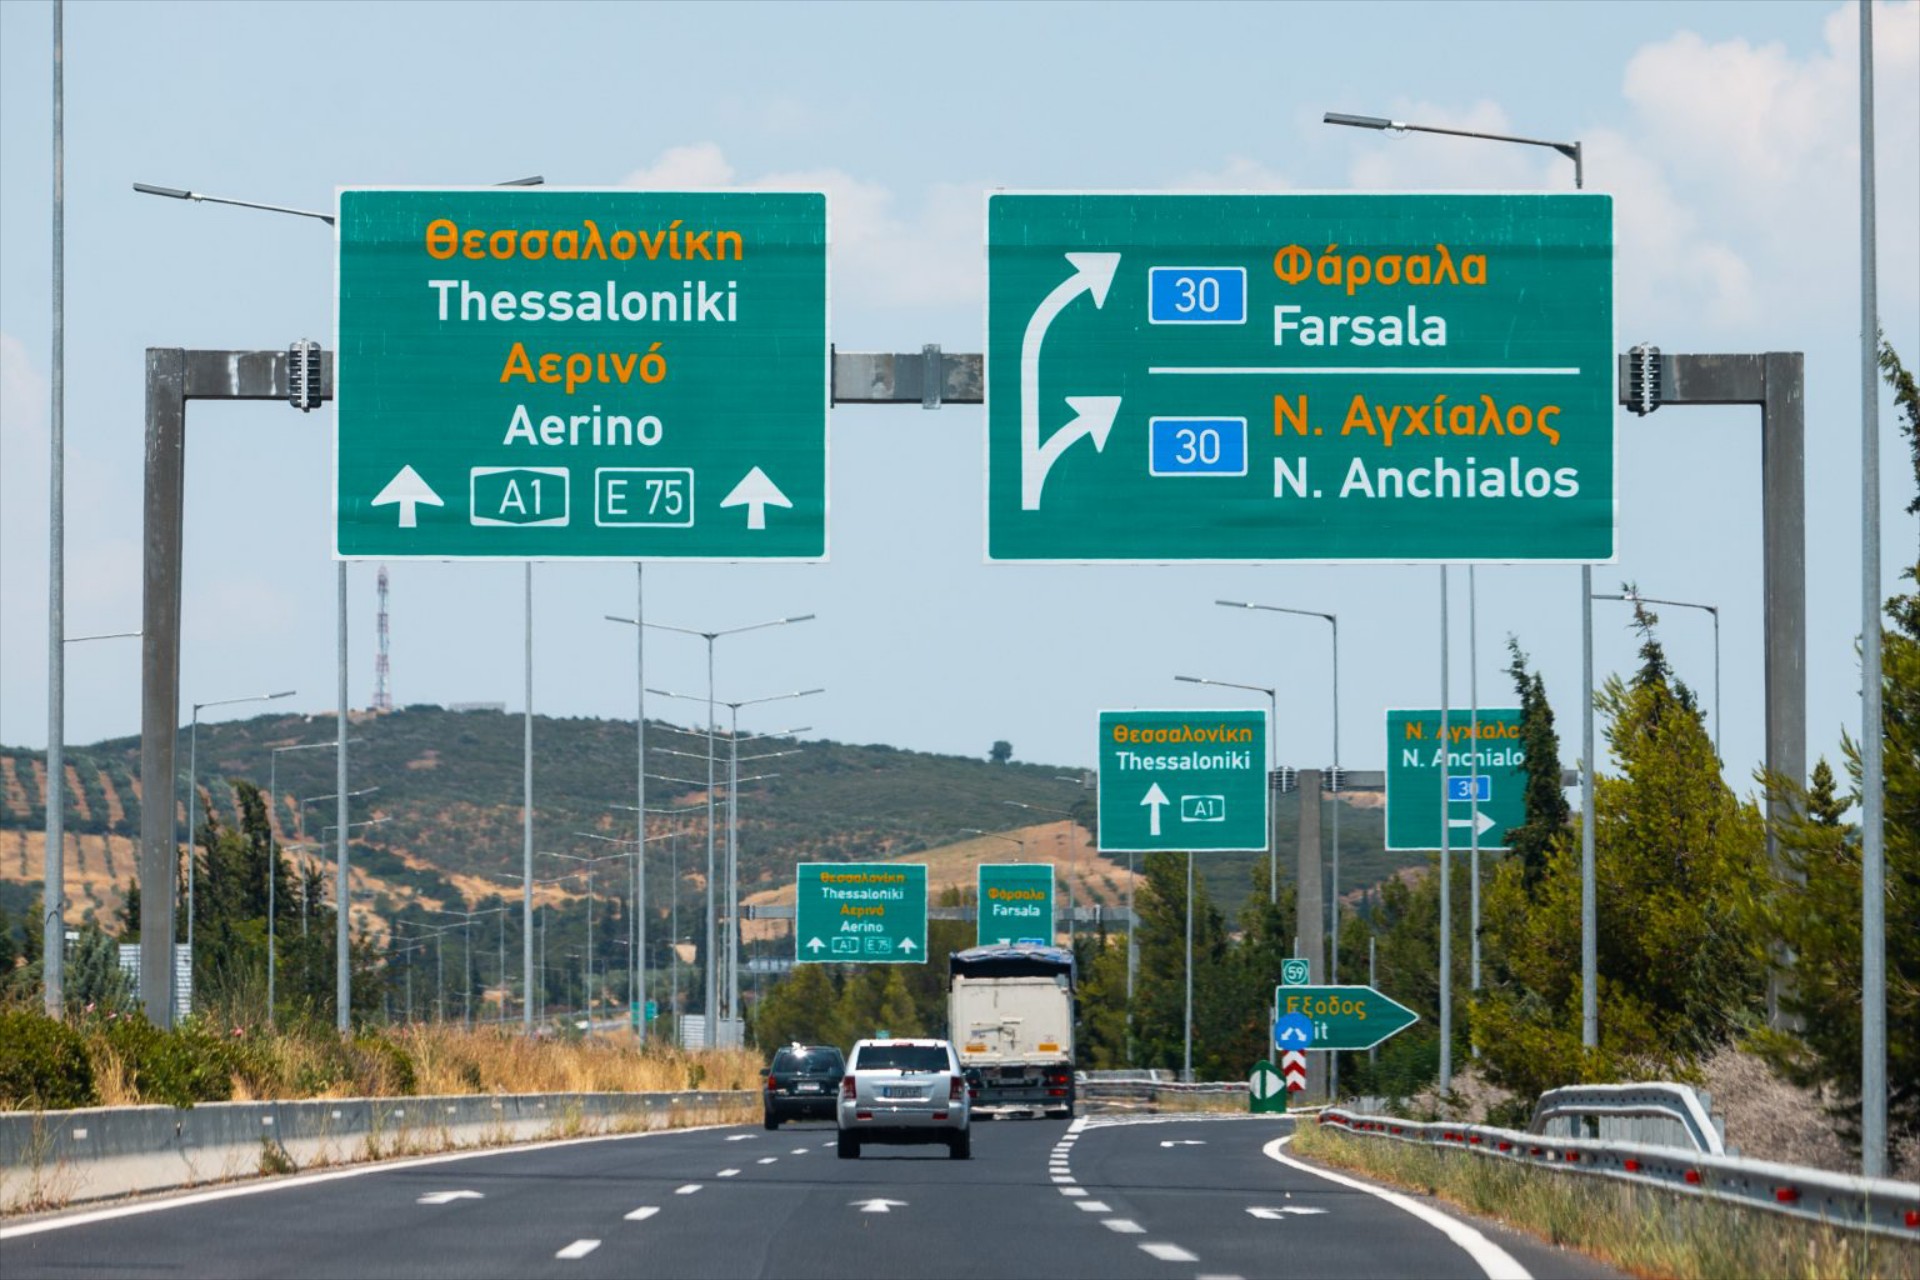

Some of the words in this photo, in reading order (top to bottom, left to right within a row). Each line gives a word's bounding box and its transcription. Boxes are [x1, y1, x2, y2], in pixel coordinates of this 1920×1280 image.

[425, 219, 743, 261] Θεσσαλονίκη
[1273, 244, 1487, 296] Φάρσαλα
[428, 279, 738, 322] Thessaloniki
[1174, 277, 1220, 313] 30
[1273, 304, 1448, 346] Farsala
[499, 341, 667, 394] Αερινό
[502, 404, 663, 446] Aerino
[1273, 394, 1324, 436] Ν.
[1340, 394, 1561, 446] Αγχίαλος
[1174, 428, 1220, 464] 30
[1273, 456, 1323, 498] N.
[1339, 456, 1581, 498] Anchialos
[498, 479, 542, 515] A1
[606, 480, 628, 515] E
[645, 480, 683, 516] 75
[1113, 724, 1253, 743] Θεσσαλονίκη
[1436, 721, 1521, 744] Αγχίαλο
[1115, 750, 1250, 770] Thessaloniki
[1402, 748, 1425, 767] N.
[1431, 747, 1525, 767] Anchialo
[1194, 800, 1214, 816] A1
[822, 886, 905, 900] Thessaloniki
[992, 903, 1041, 917] Farsala
[840, 920, 884, 933] Aerino
[1287, 966, 1304, 980] 59
